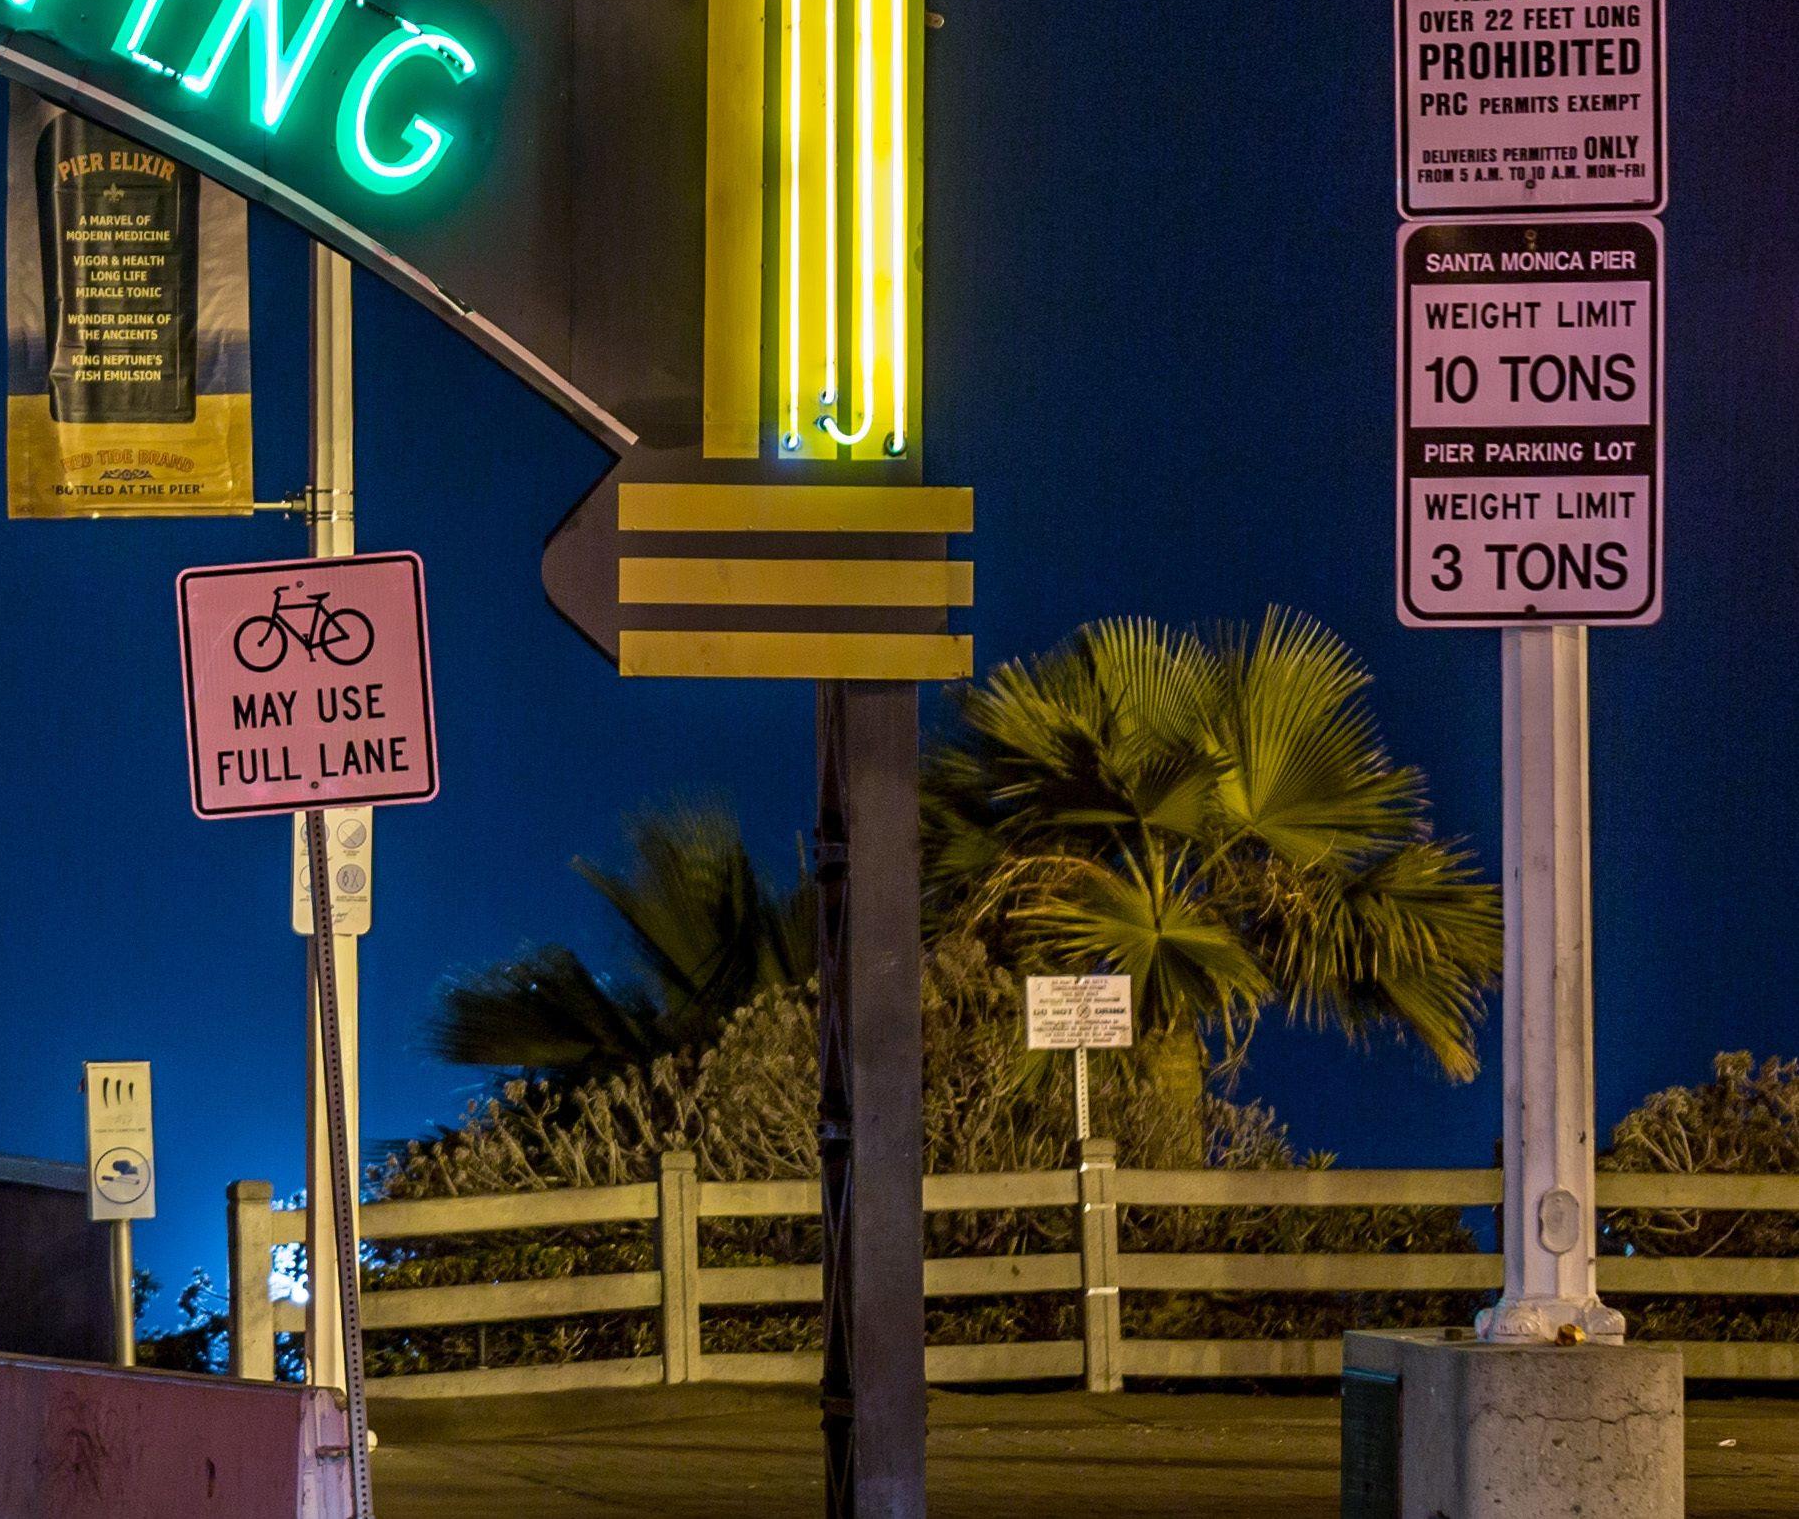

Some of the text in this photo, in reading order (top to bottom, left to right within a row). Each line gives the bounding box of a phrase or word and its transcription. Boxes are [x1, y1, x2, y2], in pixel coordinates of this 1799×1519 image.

[1419, 5, 1640, 33] OVER 22 FEET LONG
[1419, 38, 1641, 80] PROHIBITED
[1420, 92, 1641, 116] PRC PERMITS EXEMPT
[1423, 136, 1639, 164] DELIVERIES PERMITTED ONLY
[58, 152, 175, 181] PIER ELIXIR
[1418, 164, 1646, 183] FROM 5 A.M. TO 10 A.M. MON-FRI
[79, 215, 151, 225] A MARVEL OF
[66, 231, 170, 241] MODERN MEDICINE
[74, 256, 165, 266] VIGOR & HEALTH
[1426, 251, 1636, 272] SANTA MONICA PIER
[91, 271, 147, 281] LONG LIFE
[76, 287, 162, 297] MIRACLE TONIC
[68, 314, 171, 324] WONDER DRINK OF
[1425, 300, 1636, 330] WEIGHT LIMIT
[79, 330, 158, 340] THE ANCIENTS
[72, 355, 162, 365] KING NEPTUNE'S
[75, 370, 161, 380] FISH EMULSION
[1425, 353, 1636, 404] 10 TONS
[1425, 442, 1636, 463] PIER PARKING LOT
[119, 485, 135, 495] AT
[140, 485, 164, 495] THE
[1424, 492, 1635, 520] WEIGHT LIMIT
[1431, 542, 1628, 591] 3 TONS
[233, 683, 385, 730] MAY USE
[217, 737, 409, 786] FULL LANE
